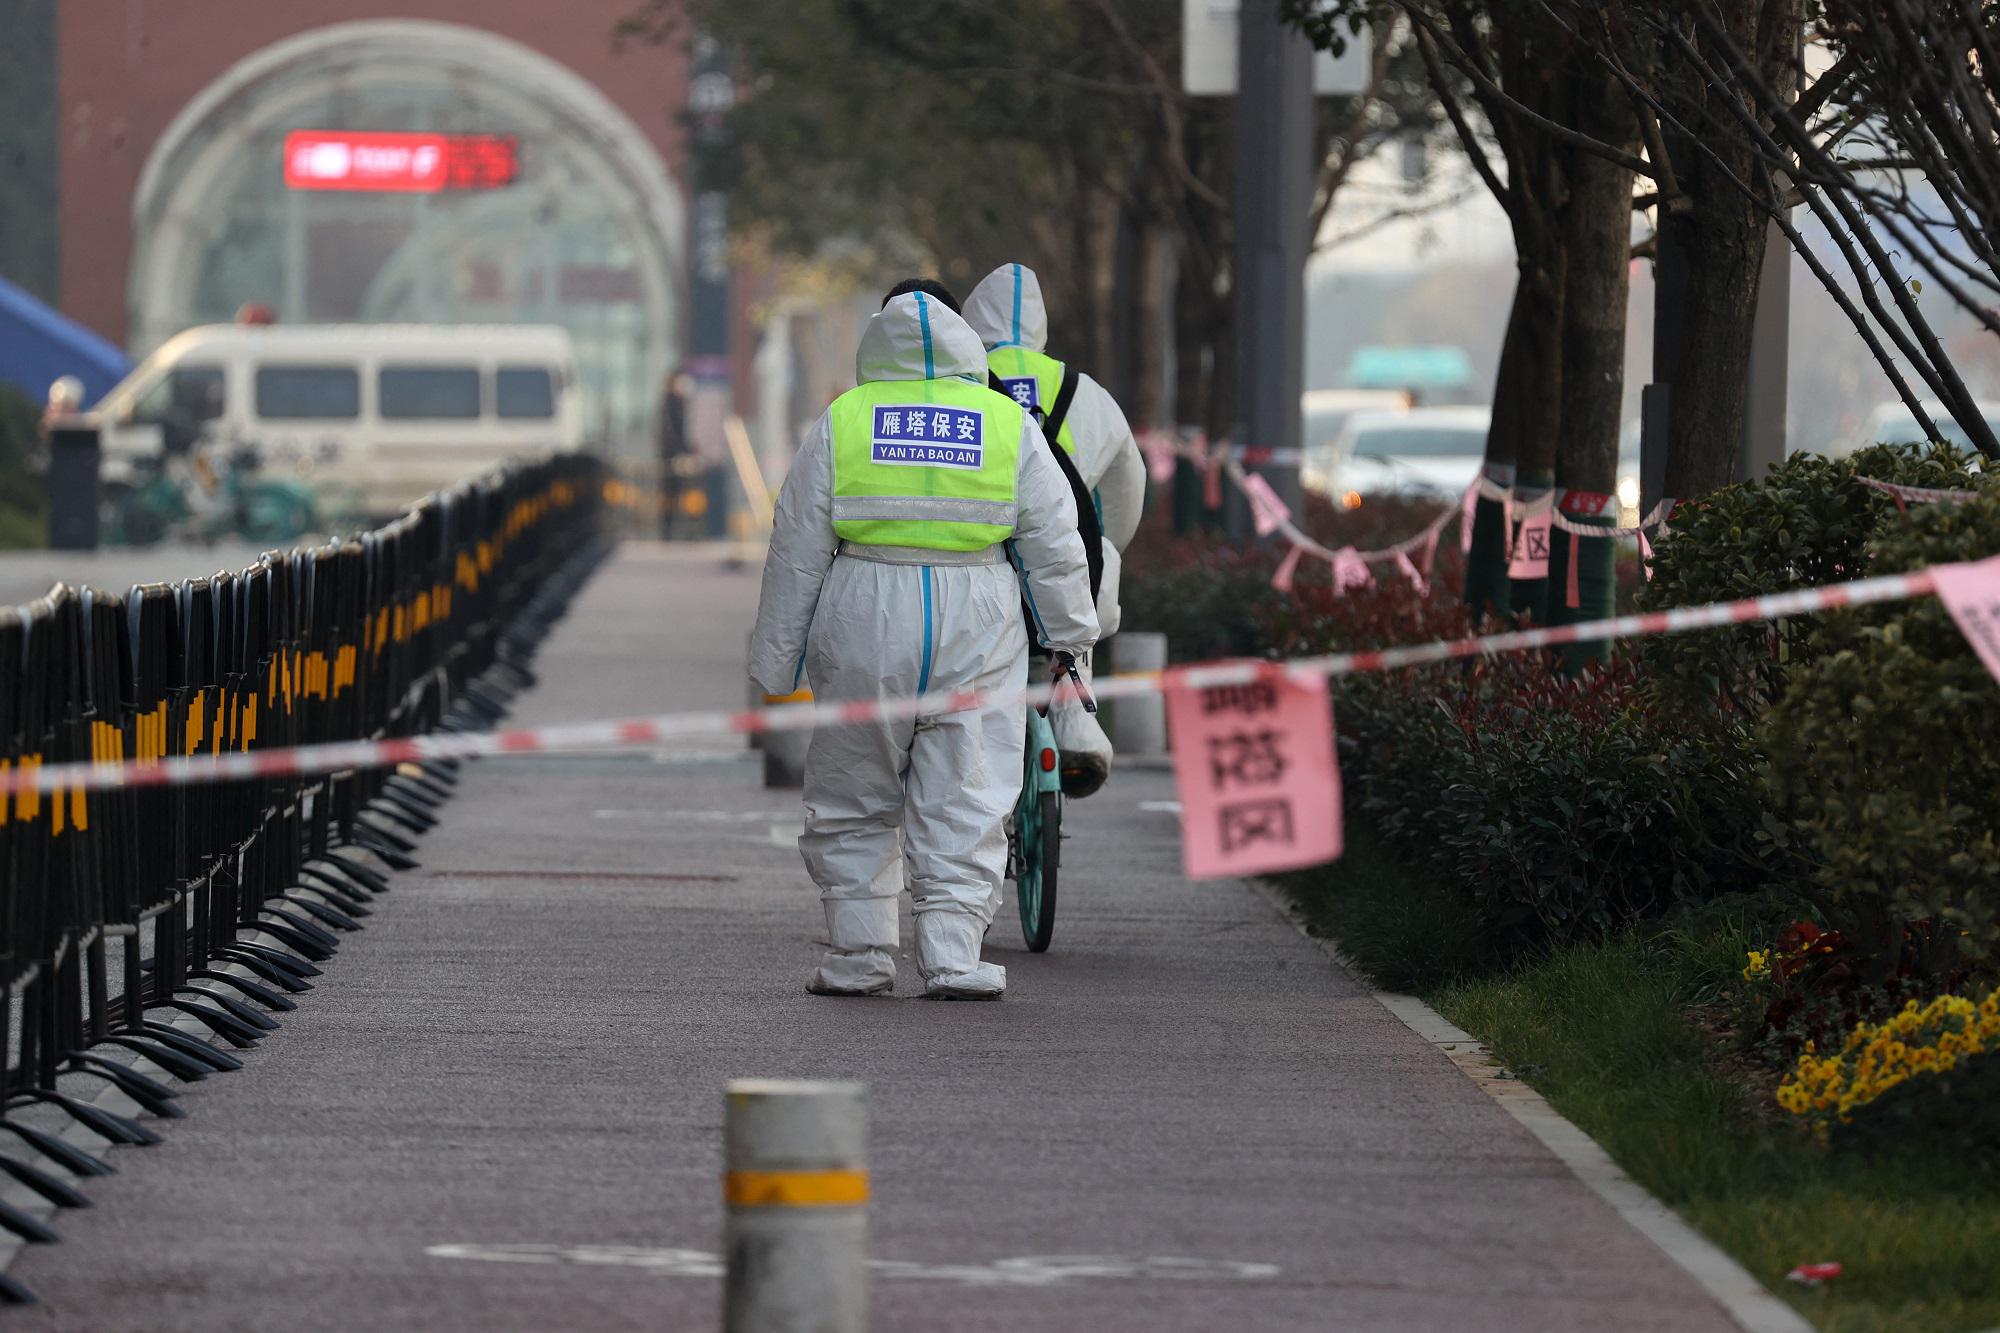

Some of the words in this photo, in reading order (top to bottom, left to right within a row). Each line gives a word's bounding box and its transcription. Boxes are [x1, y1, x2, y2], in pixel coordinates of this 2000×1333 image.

[1012, 382, 1031, 405] 安
[881, 411, 976, 441] 雁塔保安
[880, 446, 906, 459] YAN
[909, 447, 925, 460] TA
[928, 449, 954, 462] BAO
[957, 451, 975, 464] AN
